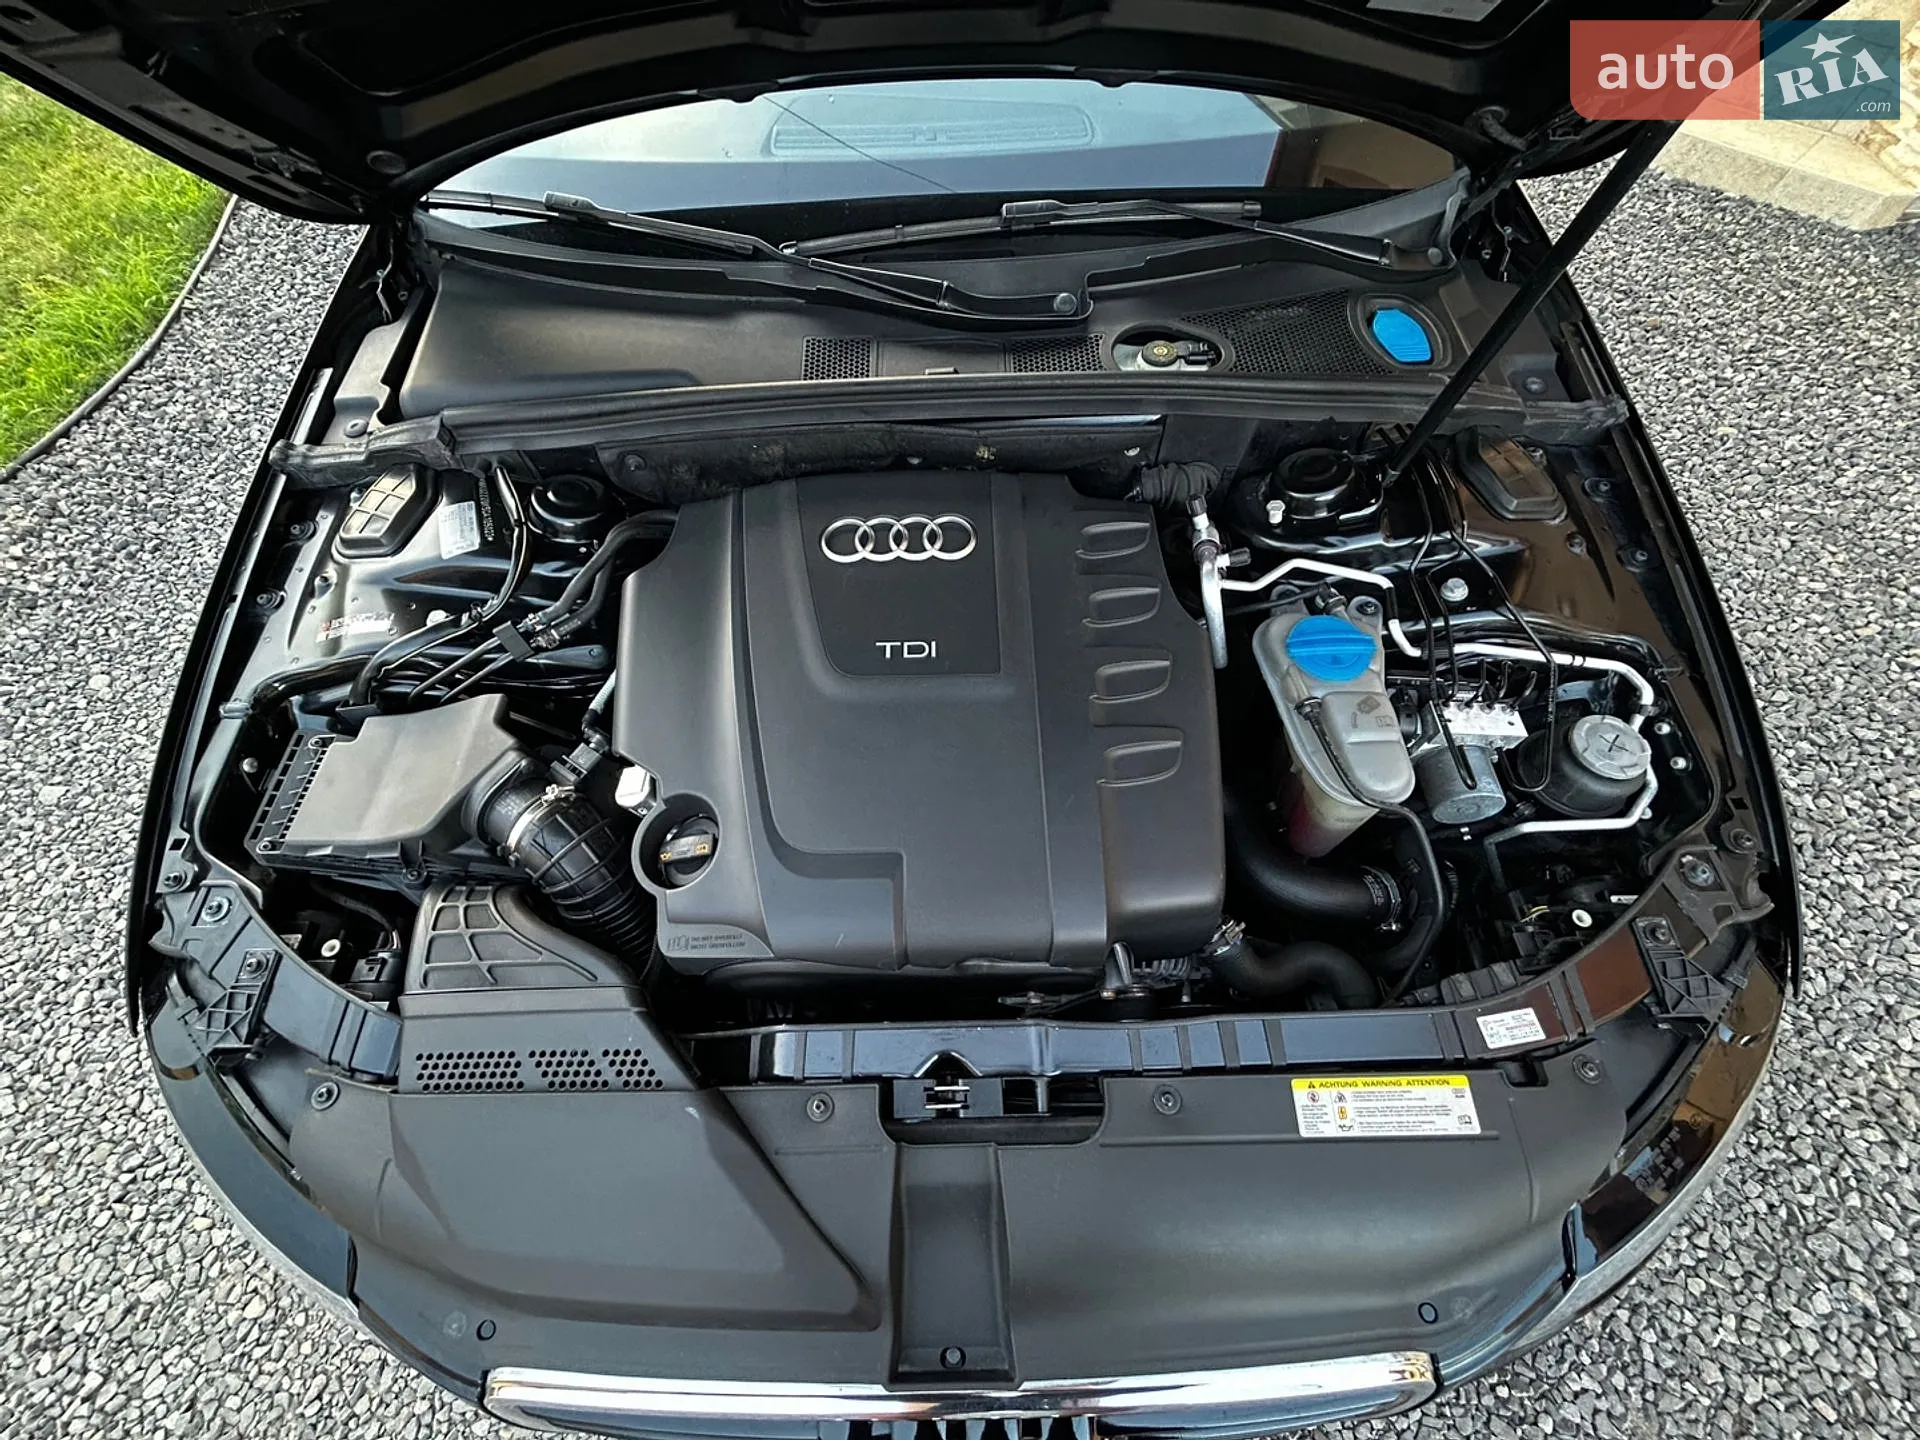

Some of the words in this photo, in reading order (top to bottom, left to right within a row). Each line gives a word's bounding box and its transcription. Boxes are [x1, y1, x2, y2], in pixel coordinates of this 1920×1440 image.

[875, 641, 937, 659] TDI
[1319, 1080, 1359, 1088] ACHTUNG
[1361, 1079, 1402, 1087] WARNING
[1406, 1078, 1450, 1086] ATTENTION
